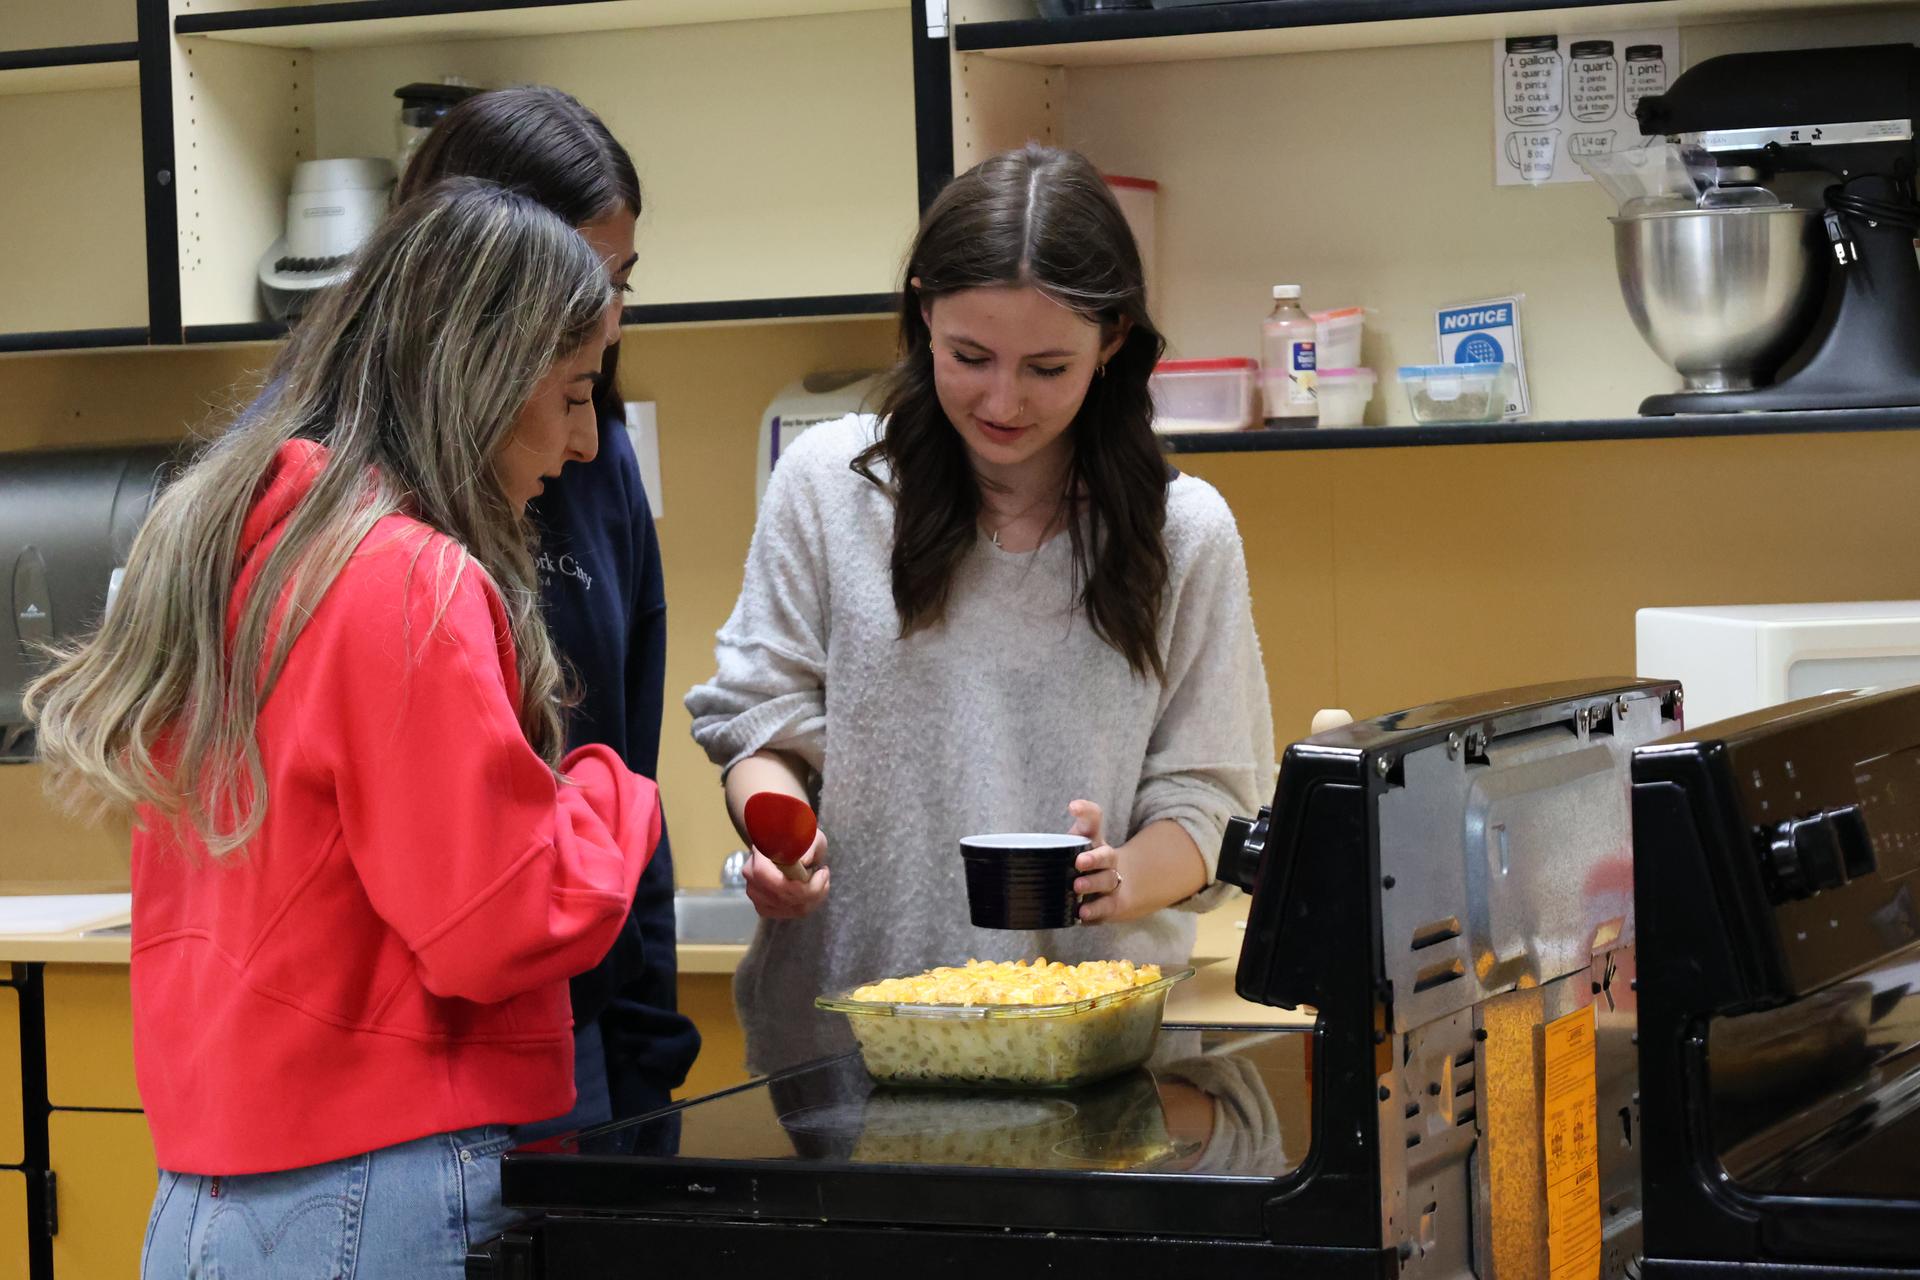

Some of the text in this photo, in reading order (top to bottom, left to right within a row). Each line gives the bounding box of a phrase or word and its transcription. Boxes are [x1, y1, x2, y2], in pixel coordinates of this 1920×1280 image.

[1509, 57, 1515, 67] 1
[1573, 62, 1579, 72] 1
[1521, 70, 1551, 79] quarts
[1628, 64, 1634, 75] 1
[1516, 81, 1547, 91] 8 pints
[1514, 93, 1550, 102] 16 cups
[1508, 104, 1559, 114] 128 ounces
[1443, 309, 1507, 329] NOTICE
[535, 552, 592, 590] ork City
